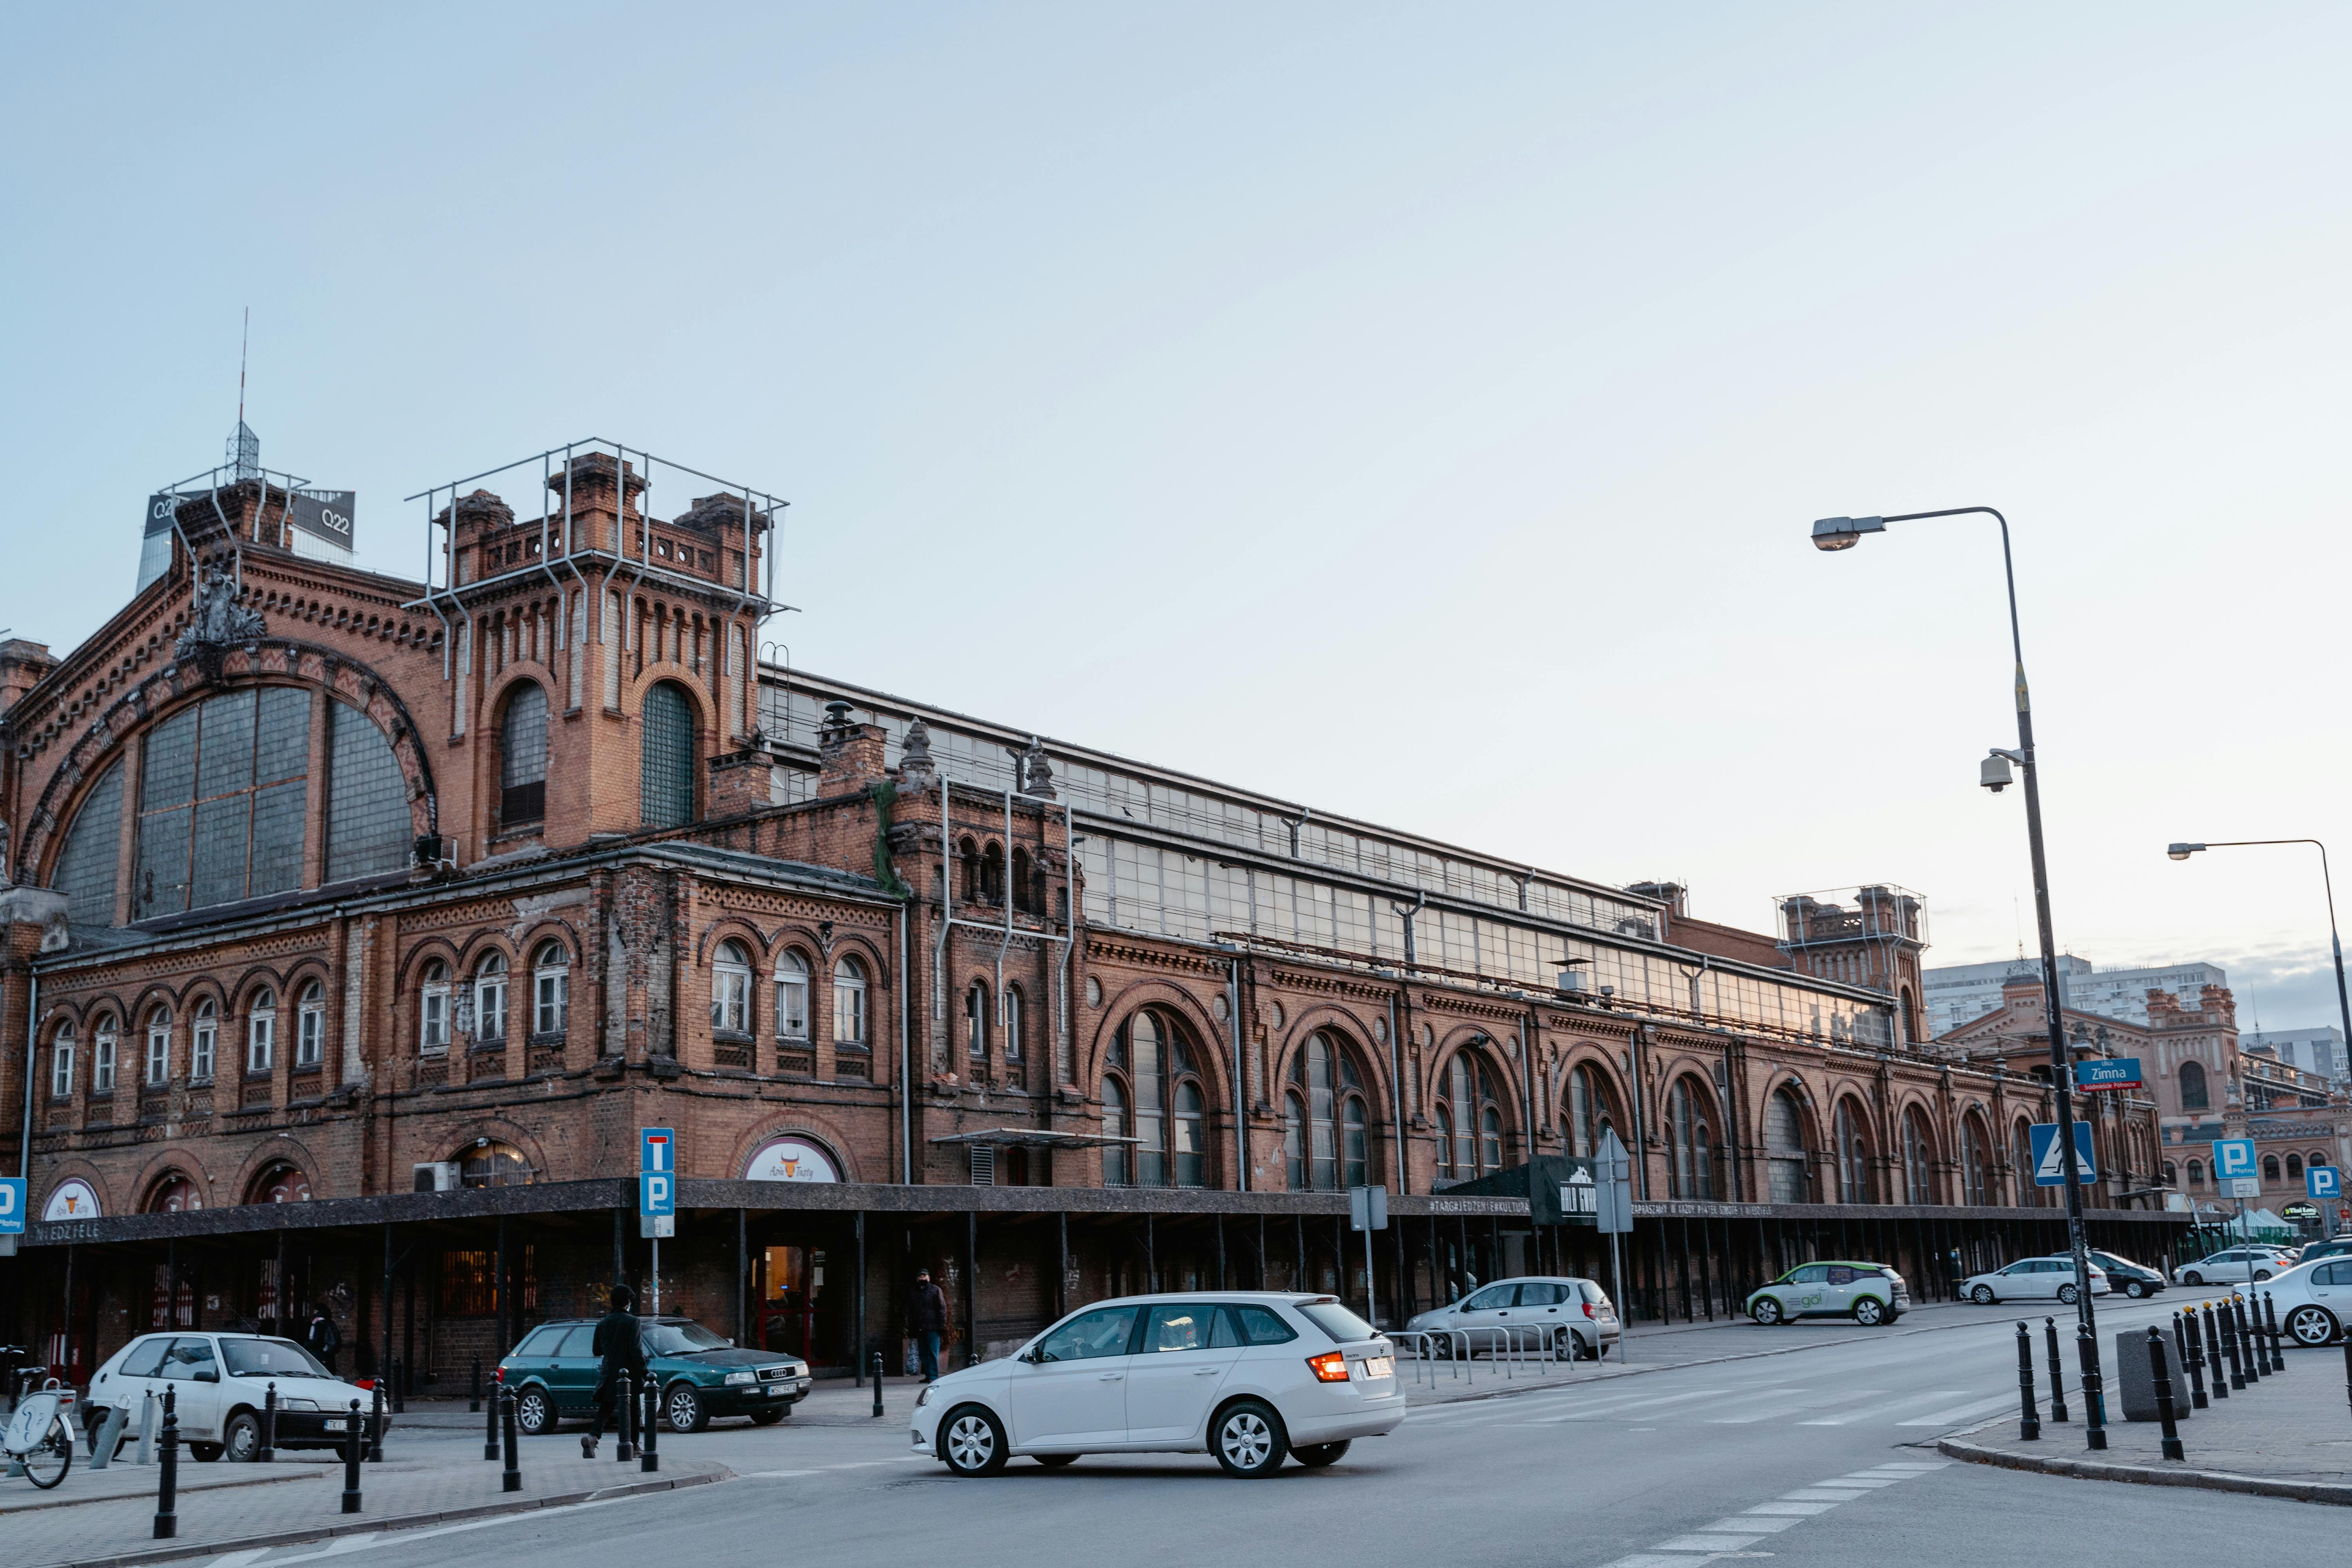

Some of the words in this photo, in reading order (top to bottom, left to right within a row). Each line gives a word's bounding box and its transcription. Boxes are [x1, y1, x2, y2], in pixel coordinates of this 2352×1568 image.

[154, 497, 180, 519] Q2
[322, 509, 349, 535] Q22
[2091, 1068, 2126, 1080] Zimna
[2222, 1143, 2248, 1174] P
[796, 1167, 813, 1180] Tasty
[2313, 1170, 2333, 1195] P
[648, 1177, 668, 1210] P
